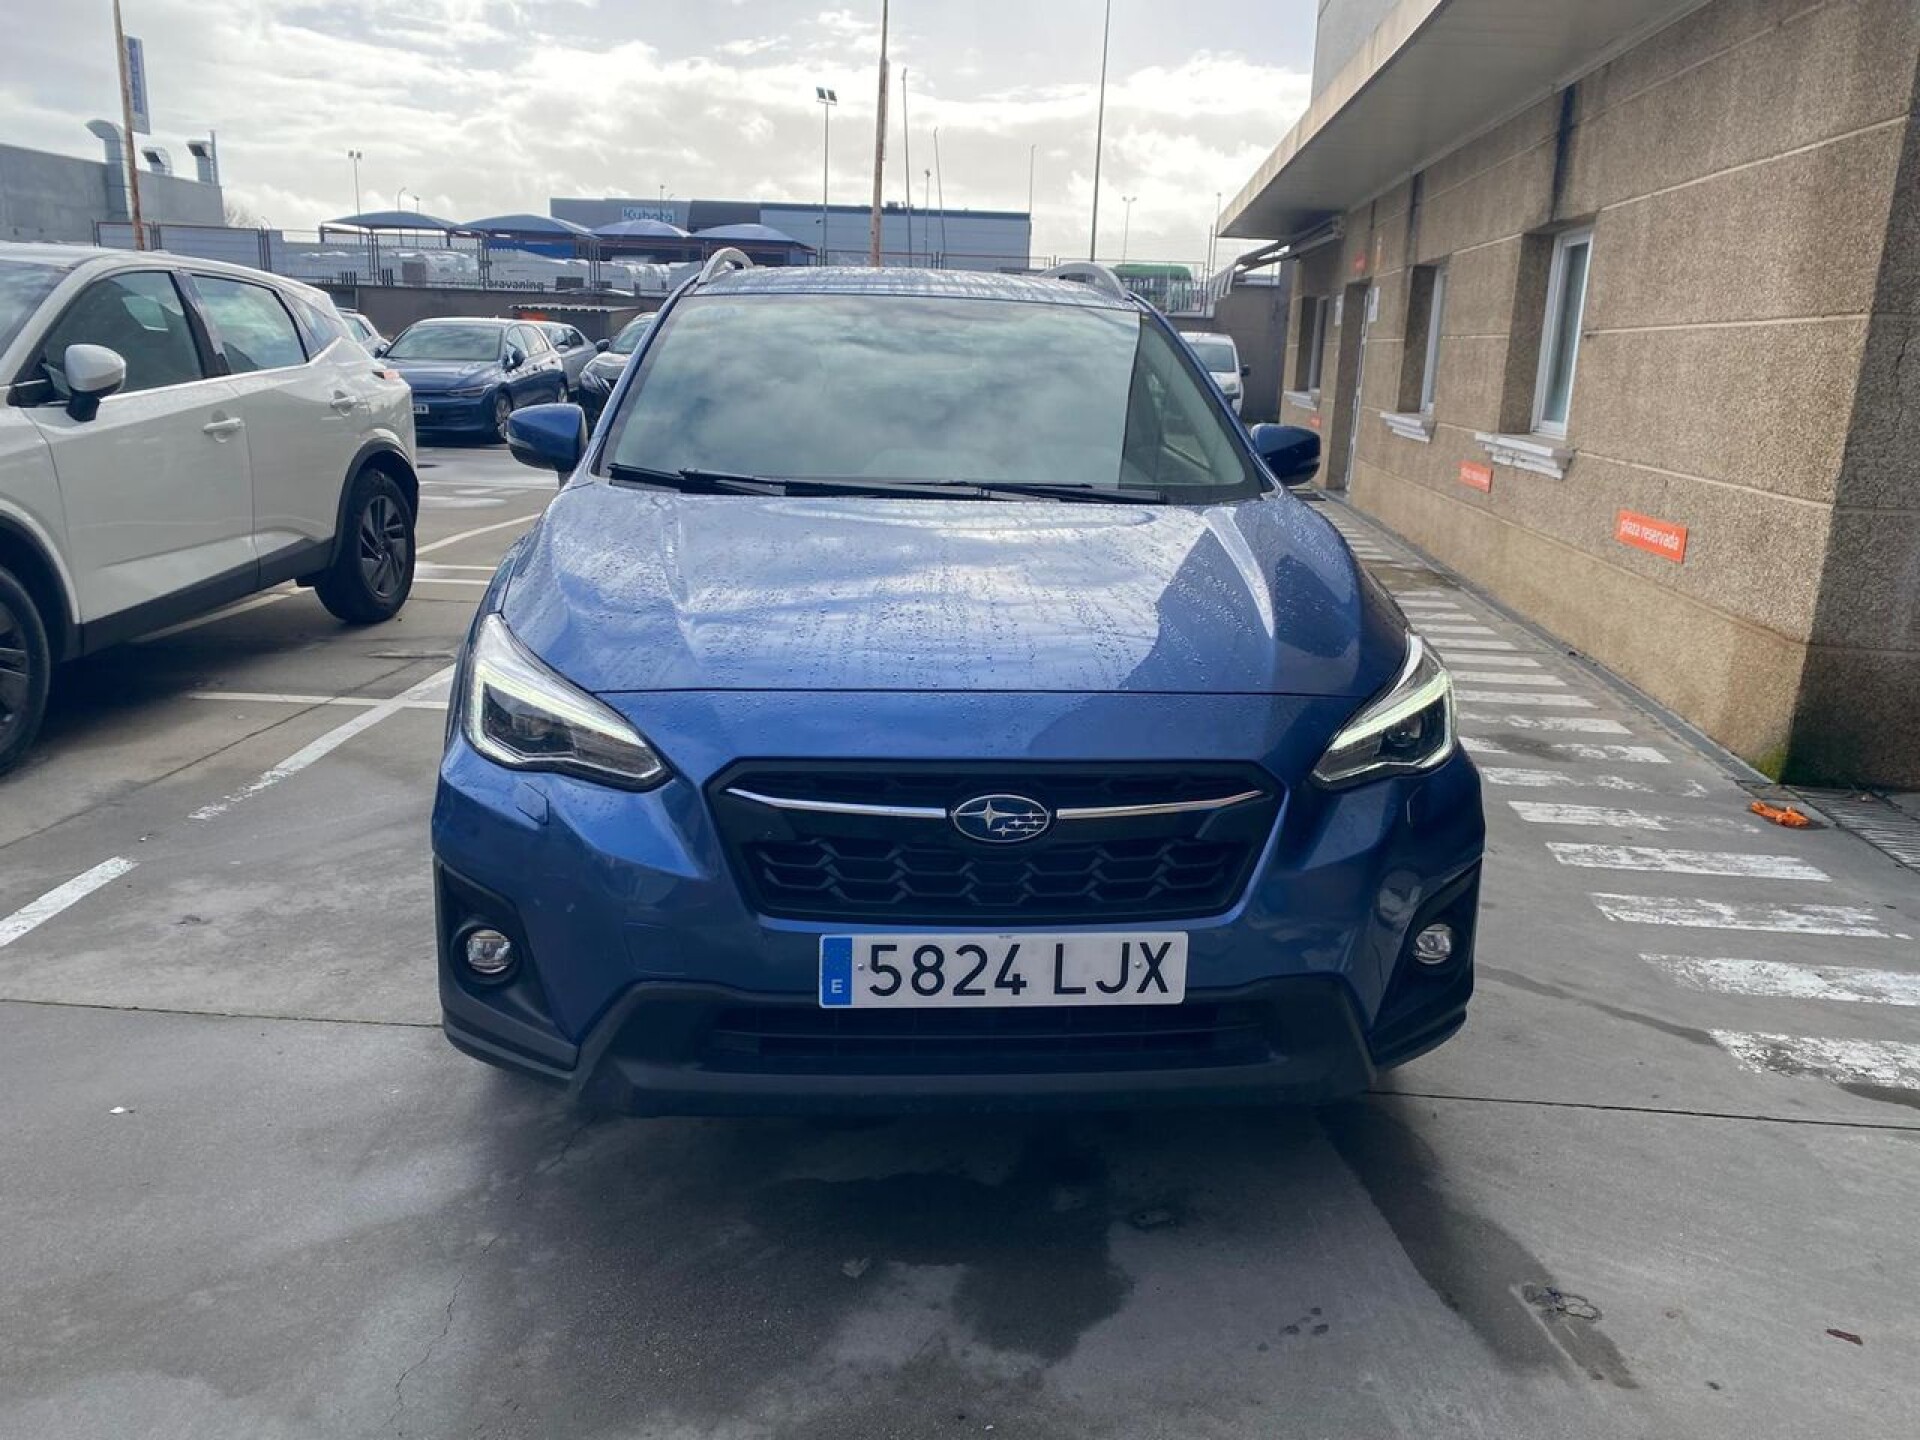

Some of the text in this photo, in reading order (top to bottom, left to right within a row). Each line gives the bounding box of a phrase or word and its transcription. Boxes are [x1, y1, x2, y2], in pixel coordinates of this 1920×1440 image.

[623, 208, 673, 223] Kubota
[1620, 517, 1680, 551] plaza reservada
[868, 941, 1173, 997] 5824 LJX
[830, 978, 844, 994] E
